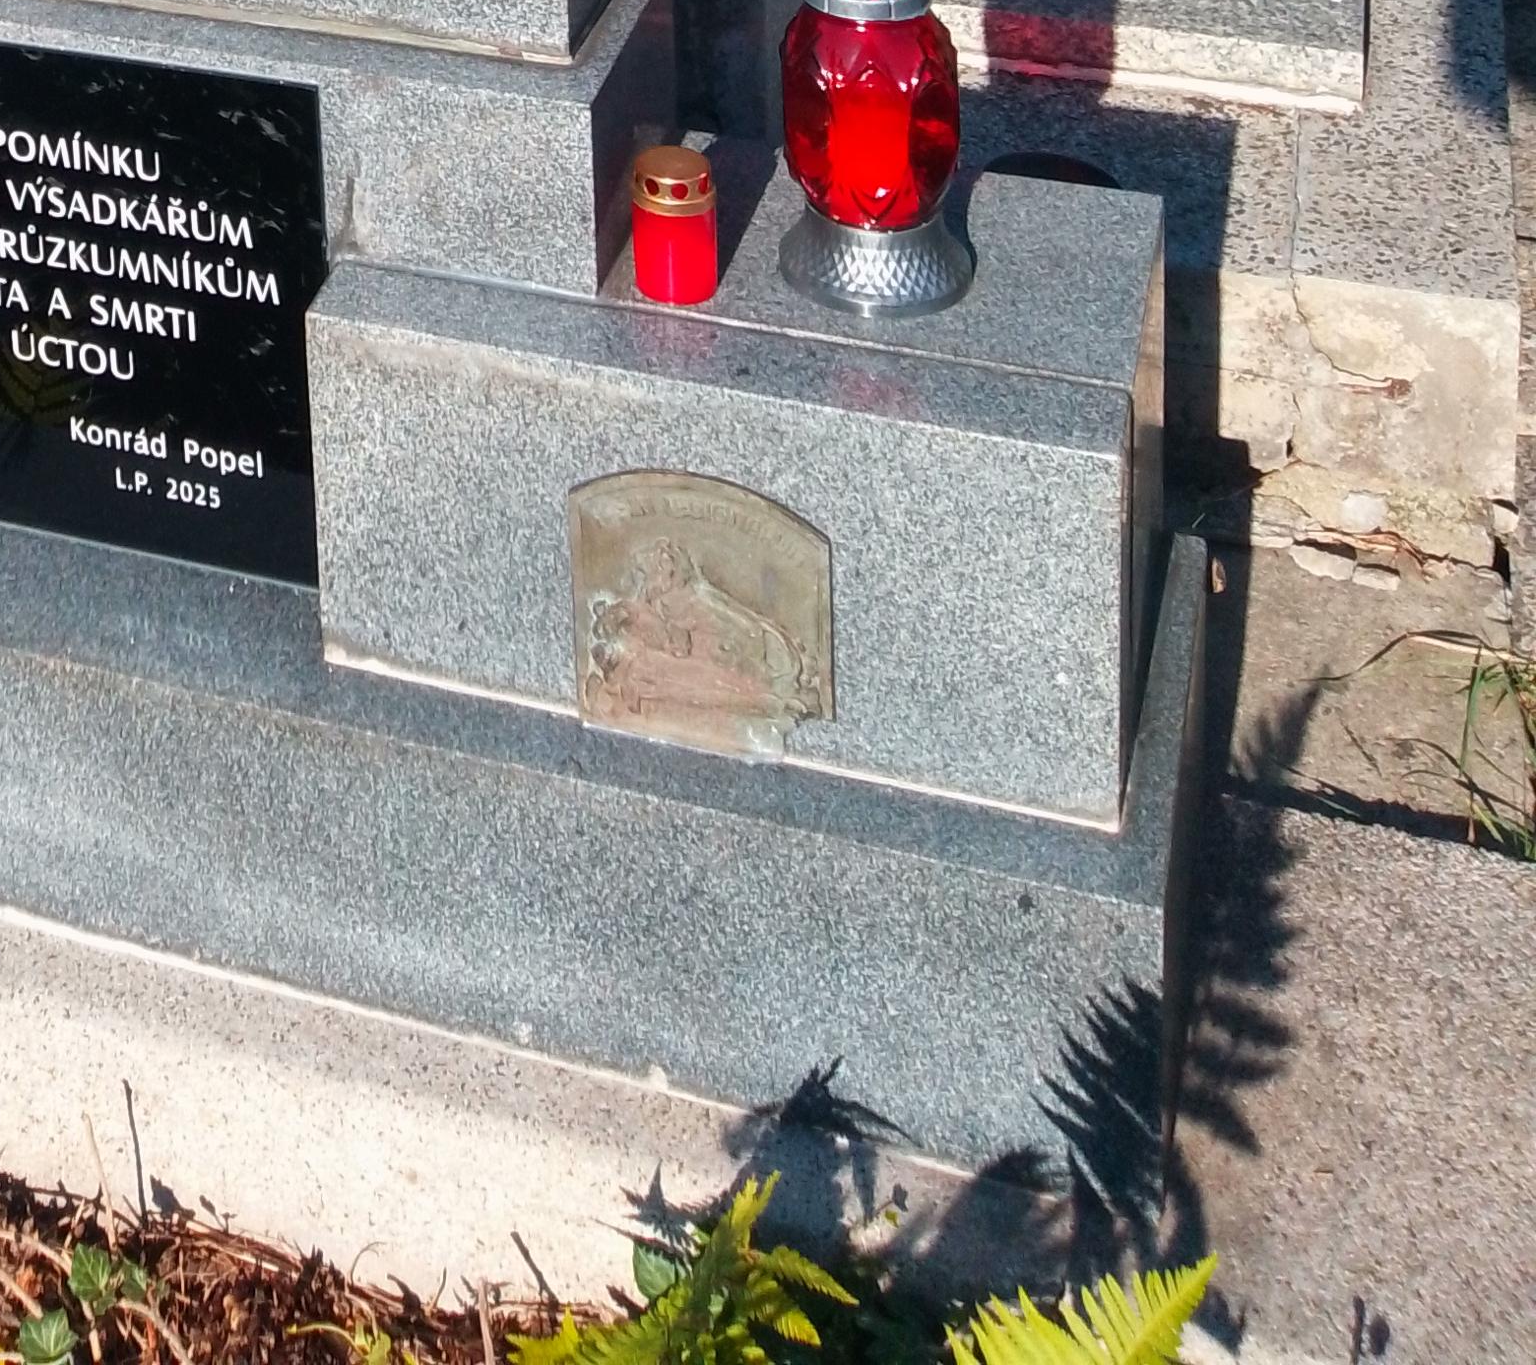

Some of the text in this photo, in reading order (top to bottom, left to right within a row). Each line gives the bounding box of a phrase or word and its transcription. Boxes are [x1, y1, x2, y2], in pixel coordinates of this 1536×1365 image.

[5, 175, 254, 249] VÝSADKÁŘŮM
[48, 286, 72, 320] A
[89, 294, 197, 342] SMRTI
[11, 322, 135, 381] ÚCTOU
[70, 416, 264, 479] Konrád Popel
[115, 466, 221, 510] L.P. 2025
